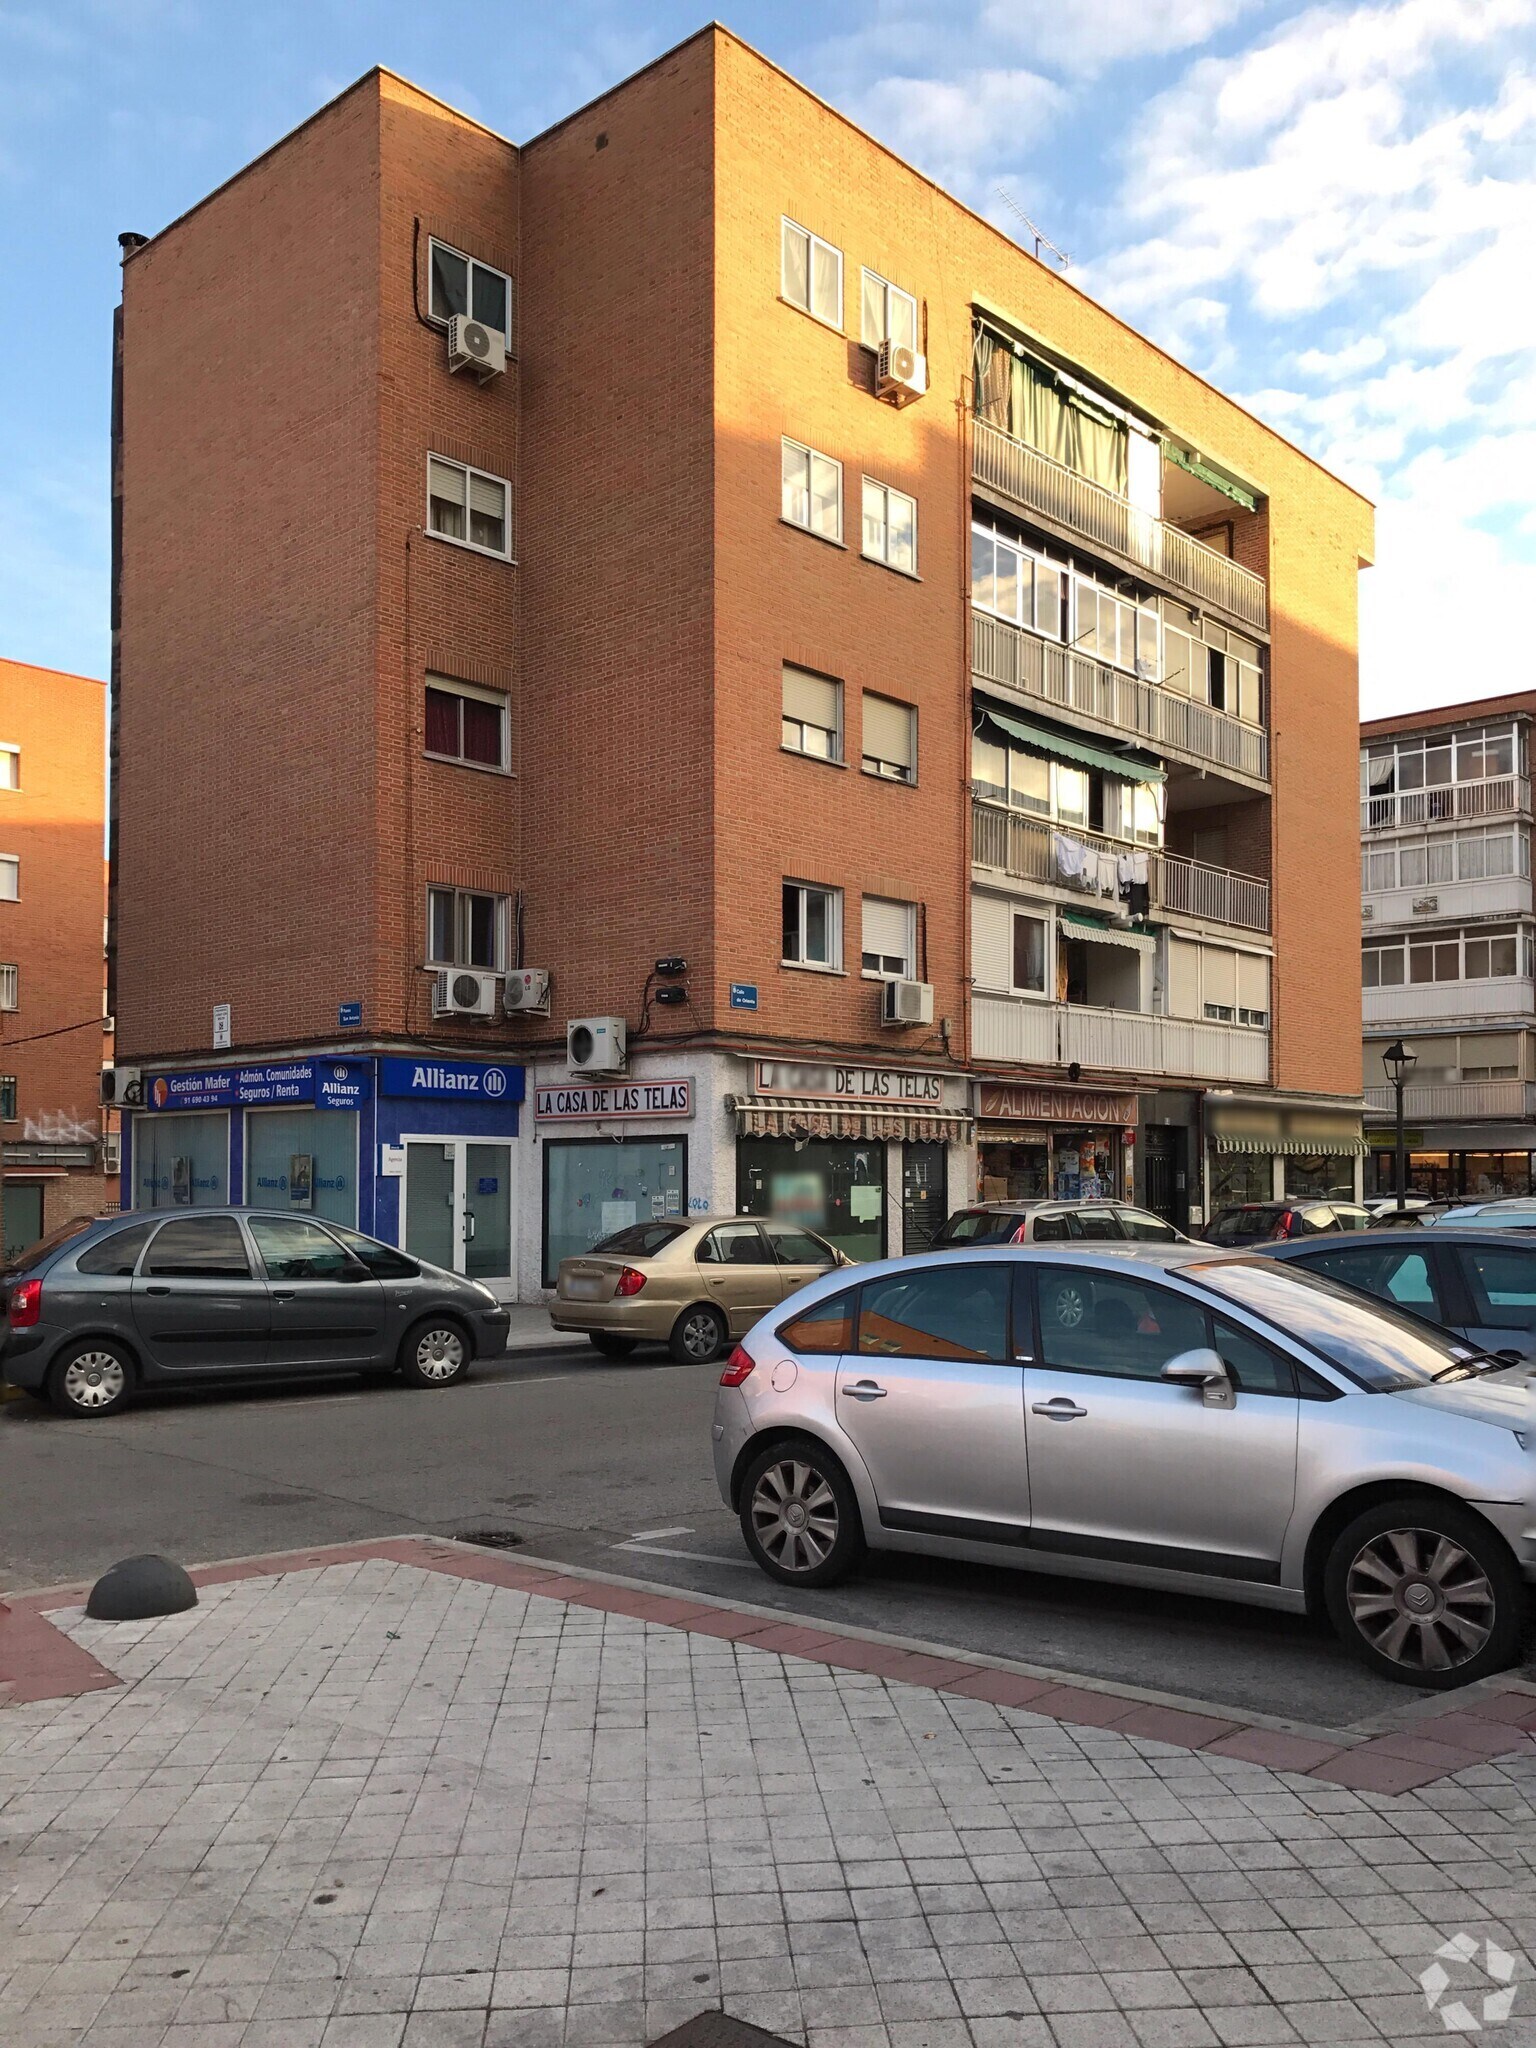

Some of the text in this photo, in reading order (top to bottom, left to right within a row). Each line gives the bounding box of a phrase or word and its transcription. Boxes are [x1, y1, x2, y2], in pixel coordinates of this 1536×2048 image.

[239, 1065, 312, 1083] Admón. Comunidades
[412, 1067, 479, 1091] Allianz
[170, 1075, 231, 1093] Gestión Mafer
[239, 1086, 270, 1102] Seguros
[276, 1084, 300, 1097] Renta
[321, 1082, 360, 1095] Allianz
[835, 1069, 855, 1094] DE
[861, 1071, 890, 1096] LAS
[896, 1075, 940, 1100] TELAS
[183, 1096, 191, 1104] 91
[203, 1095, 210, 1103] 43
[210, 1094, 218, 1102] 94
[327, 1096, 354, 1106] Seguros
[537, 1085, 687, 1115] LA CASA DE LAS TELAS
[256, 1177, 278, 1188] Allianz
